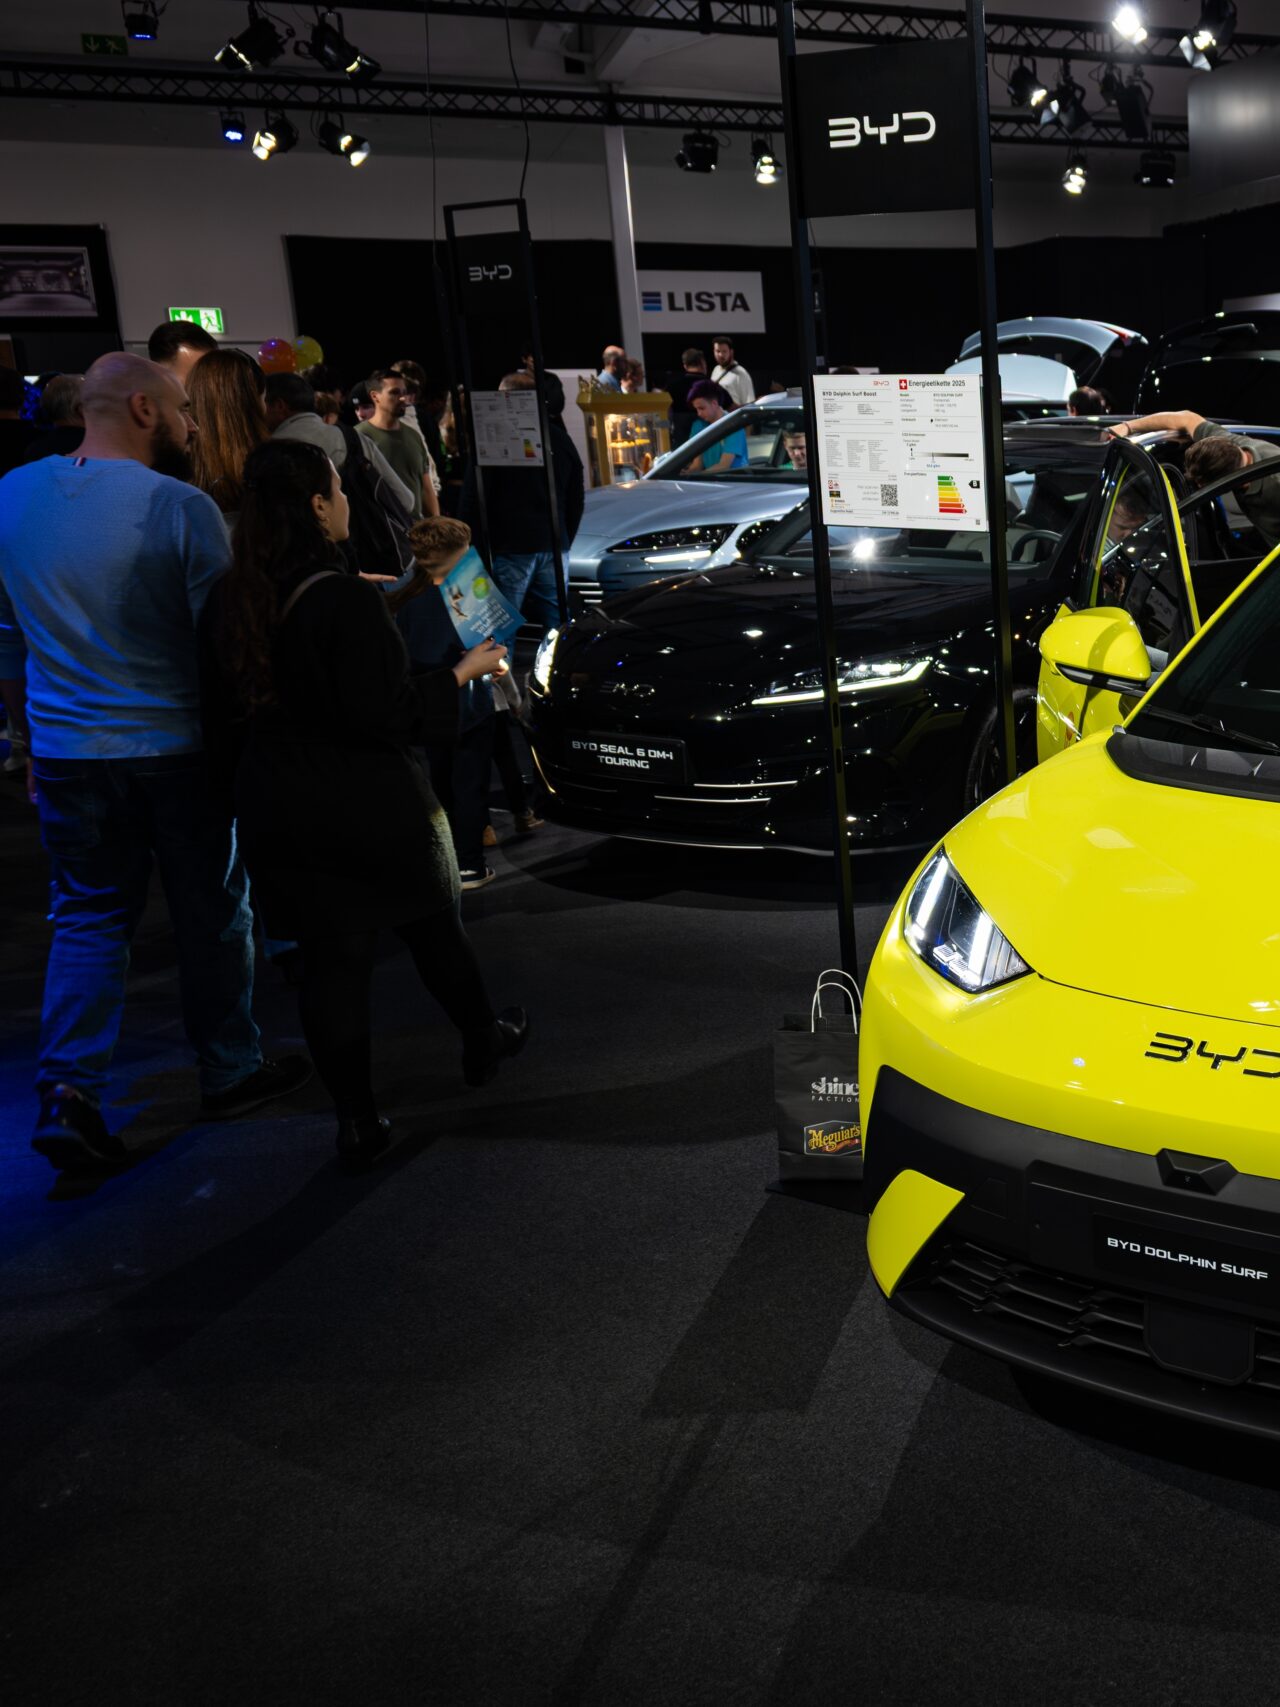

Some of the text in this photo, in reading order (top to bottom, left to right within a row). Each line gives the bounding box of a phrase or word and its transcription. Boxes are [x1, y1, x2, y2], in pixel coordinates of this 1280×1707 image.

[827, 110, 936, 149] BYD
[468, 264, 512, 282] BYD
[666, 290, 751, 313] LISTA
[908, 379, 966, 388] Energieetikette 2025
[571, 740, 598, 751] BYD
[599, 743, 634, 756] SEAL
[636, 747, 646, 757] 6
[597, 755, 650, 769] TOURING
[1106, 1236, 1269, 1280] BYD DOLPHIN SURF
